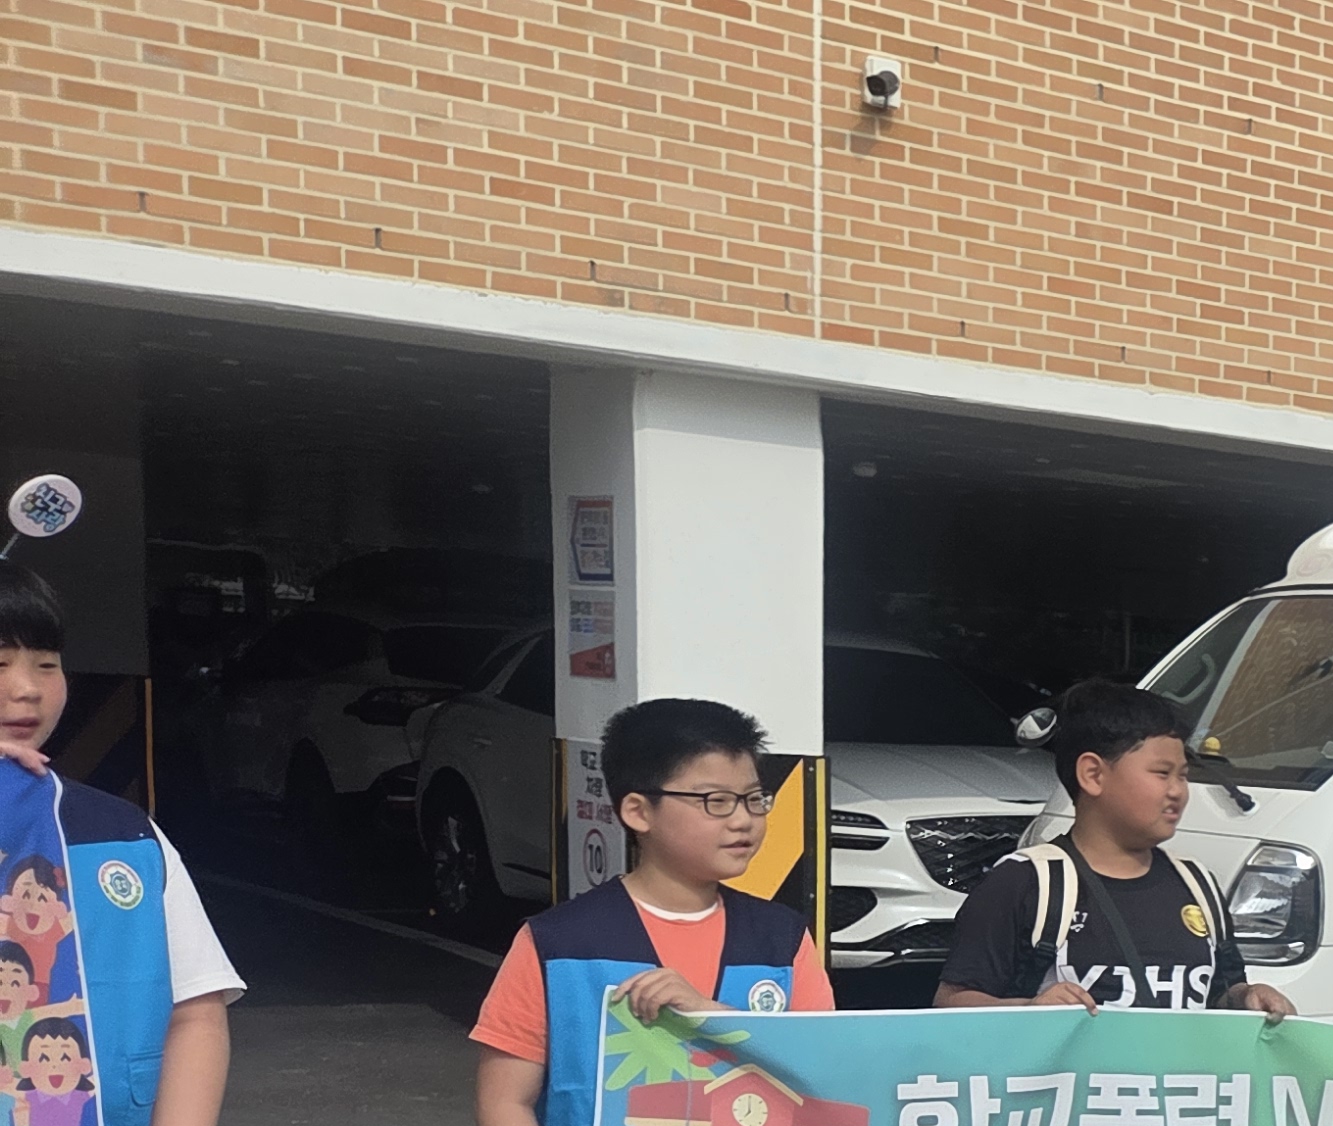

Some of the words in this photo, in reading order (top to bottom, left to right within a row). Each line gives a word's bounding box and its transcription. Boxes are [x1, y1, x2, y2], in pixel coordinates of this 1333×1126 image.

[35, 482, 67, 512] 친구
[27, 509, 67, 532] 사랑
[588, 844, 602, 874] 10
